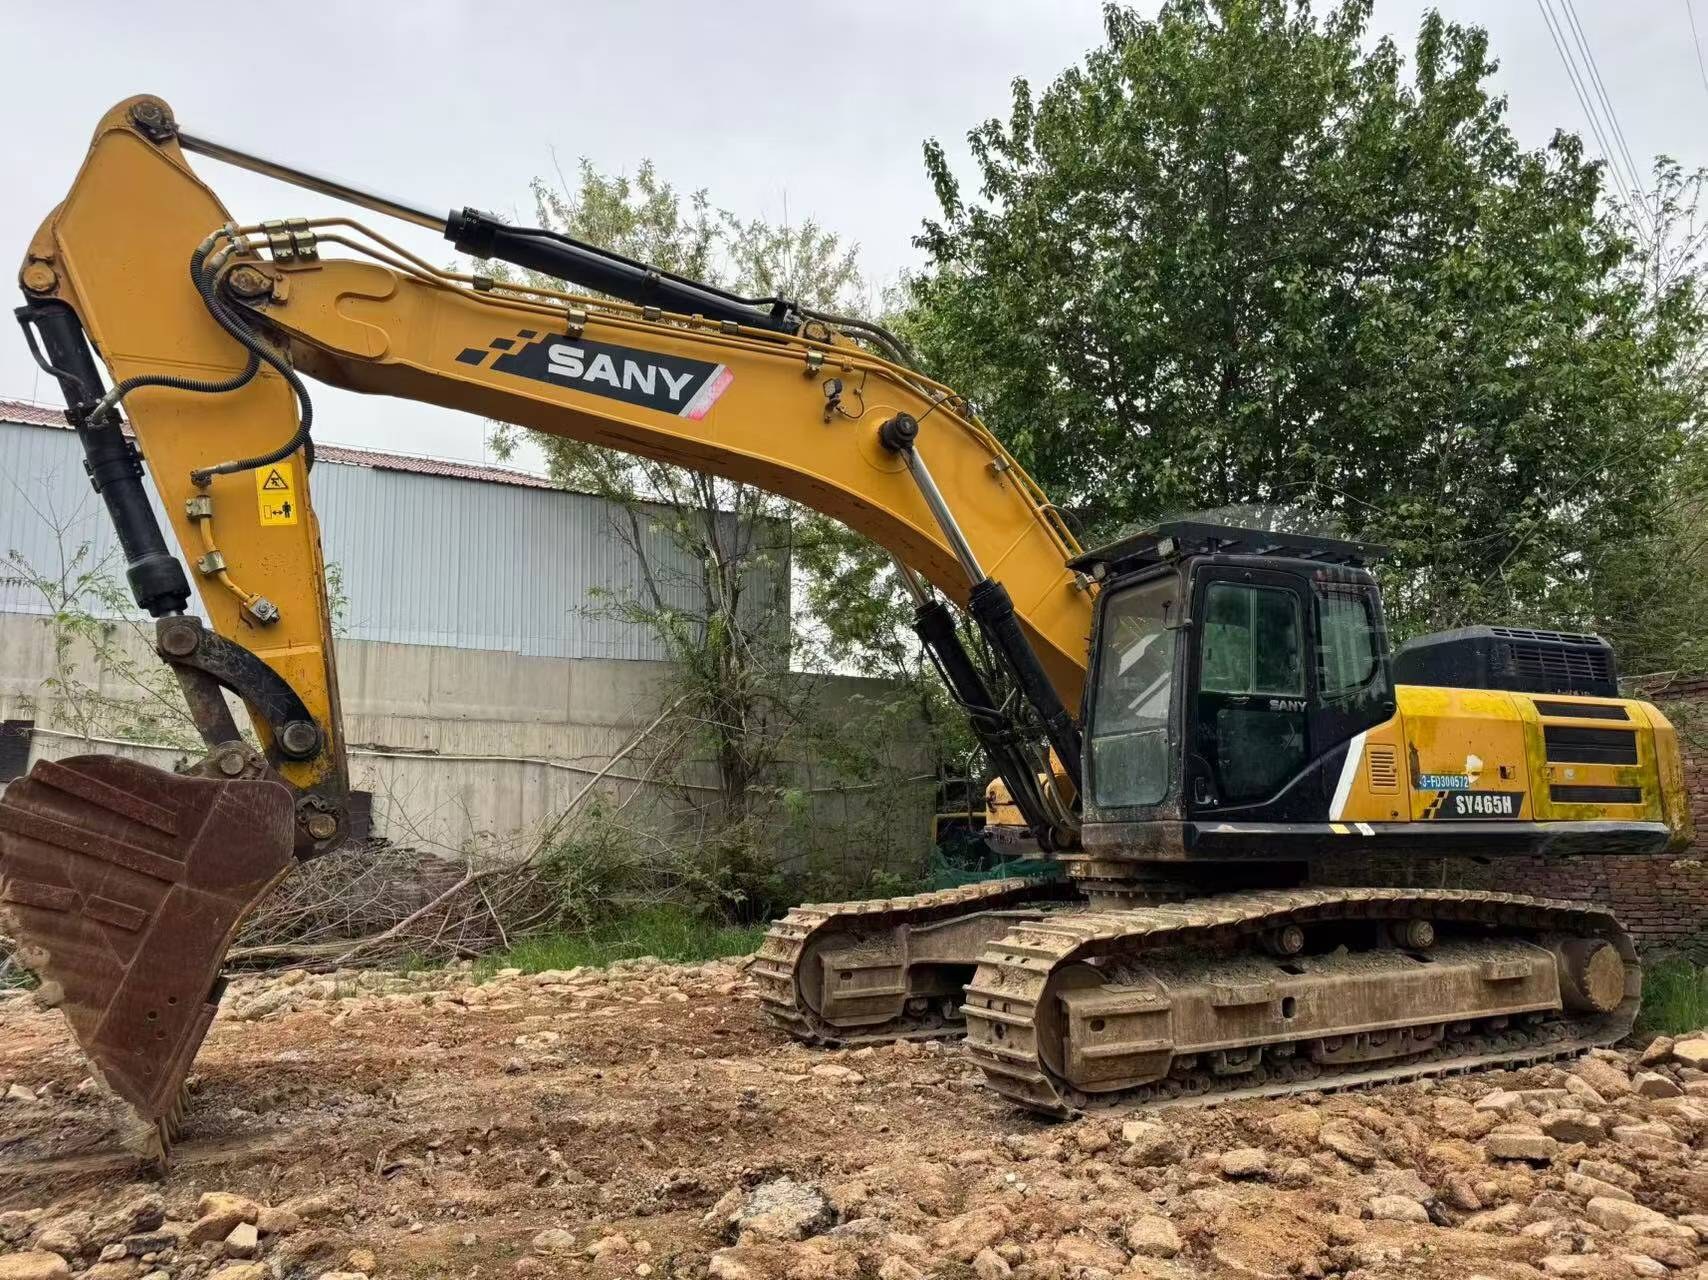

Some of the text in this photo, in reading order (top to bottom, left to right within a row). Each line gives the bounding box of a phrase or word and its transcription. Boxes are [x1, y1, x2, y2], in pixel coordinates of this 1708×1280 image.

[548, 344, 695, 401] SANY
[1270, 700, 1308, 712] SANY
[1419, 775, 1469, 788] 3-FD300572
[1455, 795, 1513, 815] SY465H
